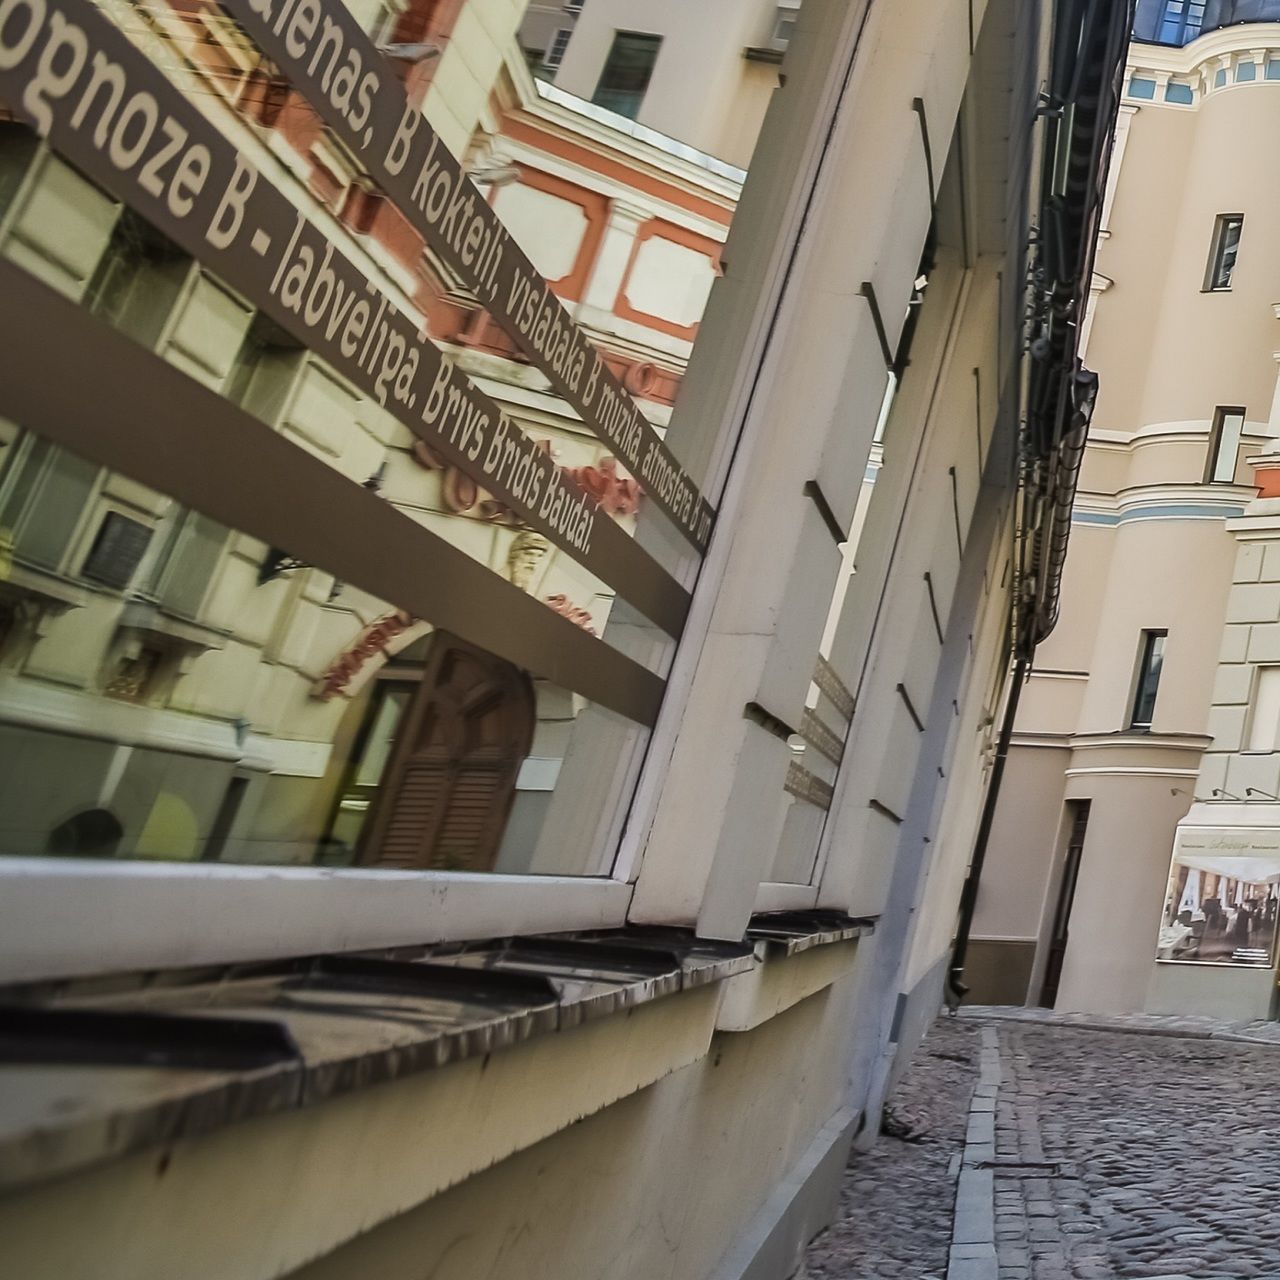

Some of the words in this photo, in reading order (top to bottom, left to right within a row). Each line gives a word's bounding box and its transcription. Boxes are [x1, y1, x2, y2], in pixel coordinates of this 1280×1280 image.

[205, 150, 258, 250] B
[269, 209, 429, 410] labvēlīgā.
[422, 351, 490, 462] Brīvs
[482, 410, 546, 510] Brīdis
[538, 463, 600, 556] Baudai.
[383, 94, 422, 177] B
[411, 133, 510, 302] kokteiļi,
[506, 266, 591, 394] vislabākā
[582, 349, 604, 407] B
[595, 382, 643, 470] mūzika,
[641, 442, 693, 524] atmosfēra
[688, 492, 703, 532] B
